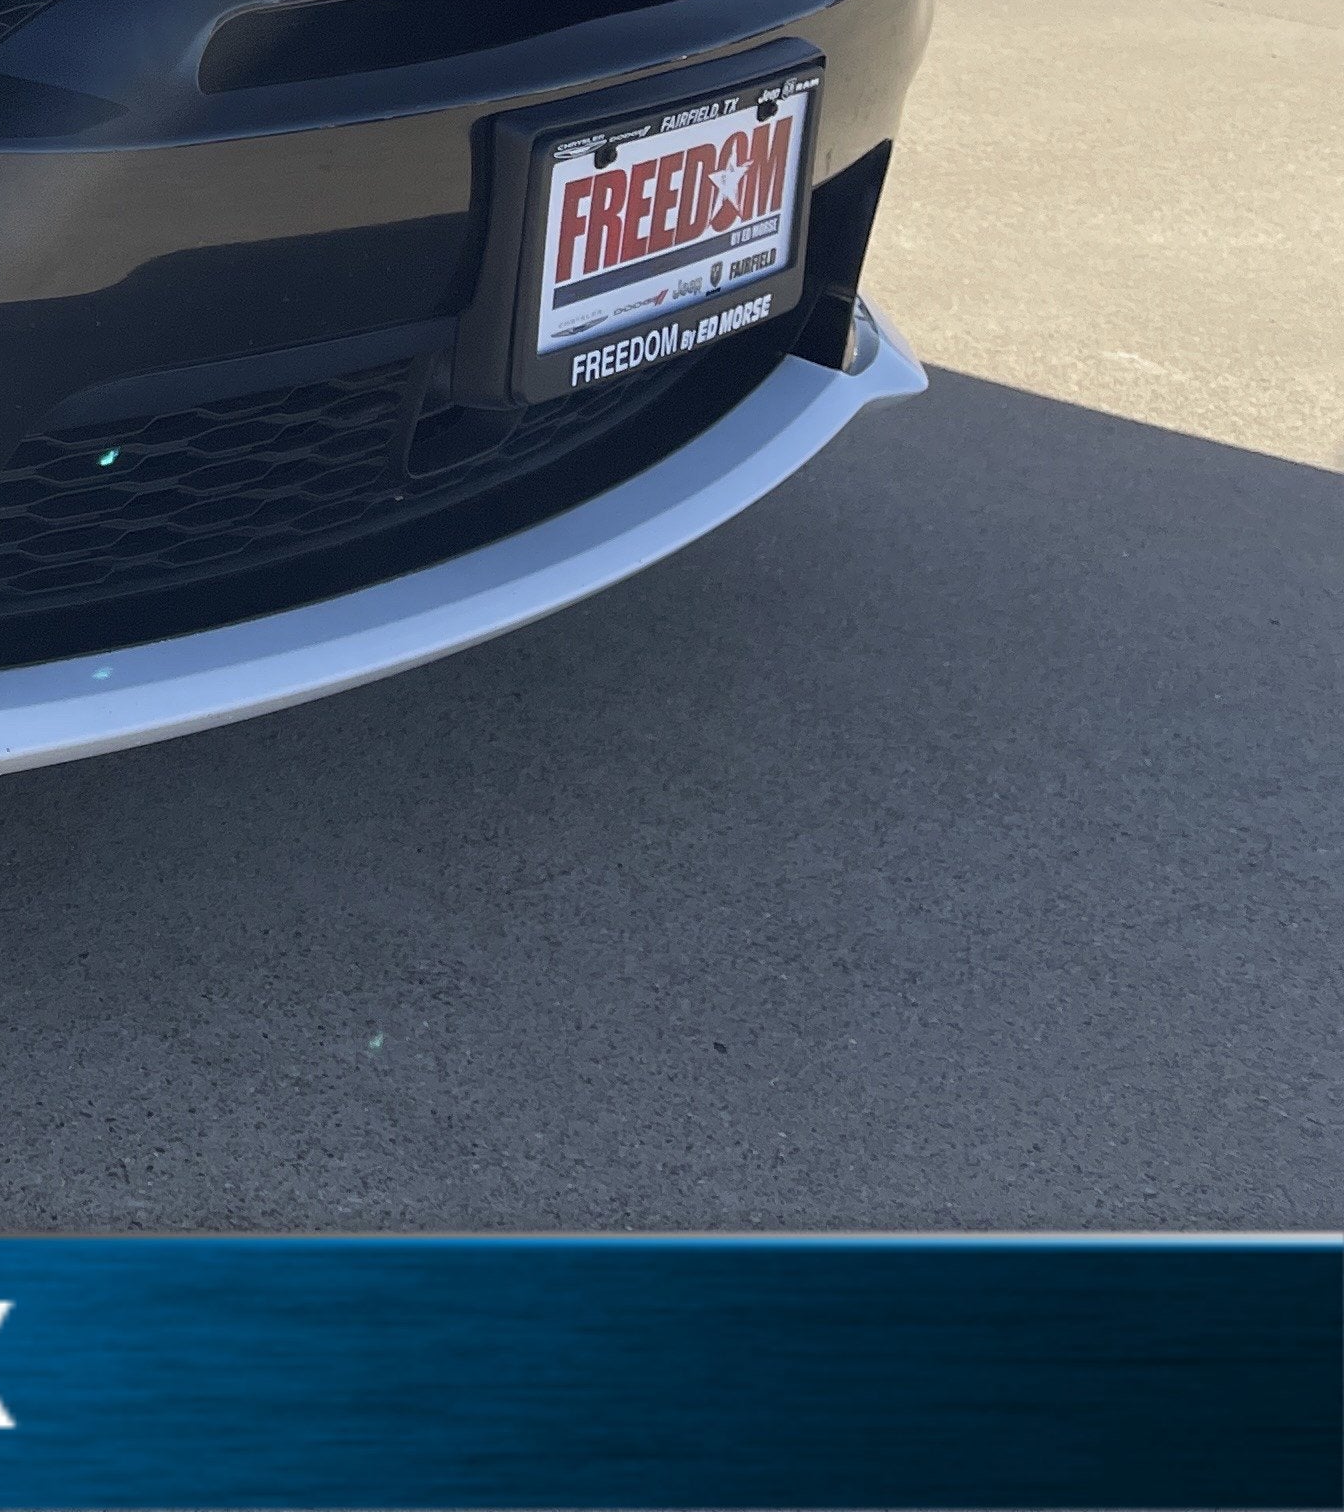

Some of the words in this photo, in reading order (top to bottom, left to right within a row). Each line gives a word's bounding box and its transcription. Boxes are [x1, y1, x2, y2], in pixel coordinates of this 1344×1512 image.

[723, 97, 740, 115] TX
[555, 115, 793, 283] FREEDOM
[571, 323, 679, 387] FREEDOM
[697, 315, 719, 344] ED
[719, 293, 772, 336] MORSE
